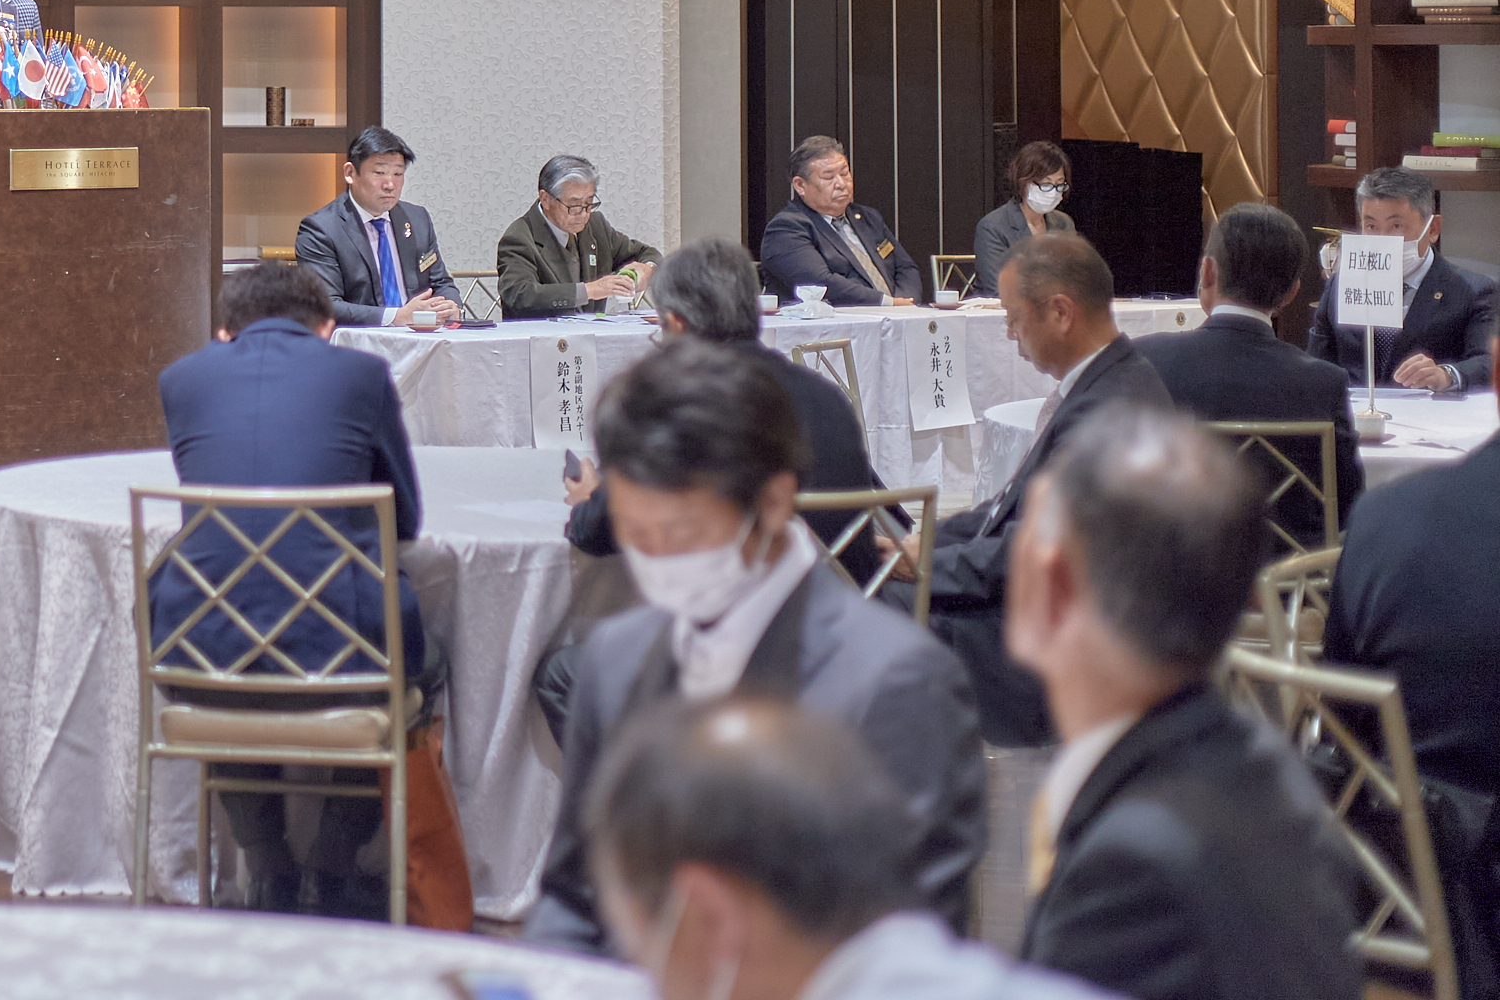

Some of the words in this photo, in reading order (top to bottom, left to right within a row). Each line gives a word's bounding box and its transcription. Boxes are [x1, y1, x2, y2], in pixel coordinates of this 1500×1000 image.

[85, 159, 131, 169] TERRACE
[1347, 250, 1392, 272] 日立桜LC
[1343, 287, 1395, 307] 常陸太田LC
[929, 341, 942, 373] 永井
[557, 361, 570, 394] 鈴木
[573, 355, 585, 442] 第2副地区ガバナー
[558, 399, 572, 433] 孝昌
